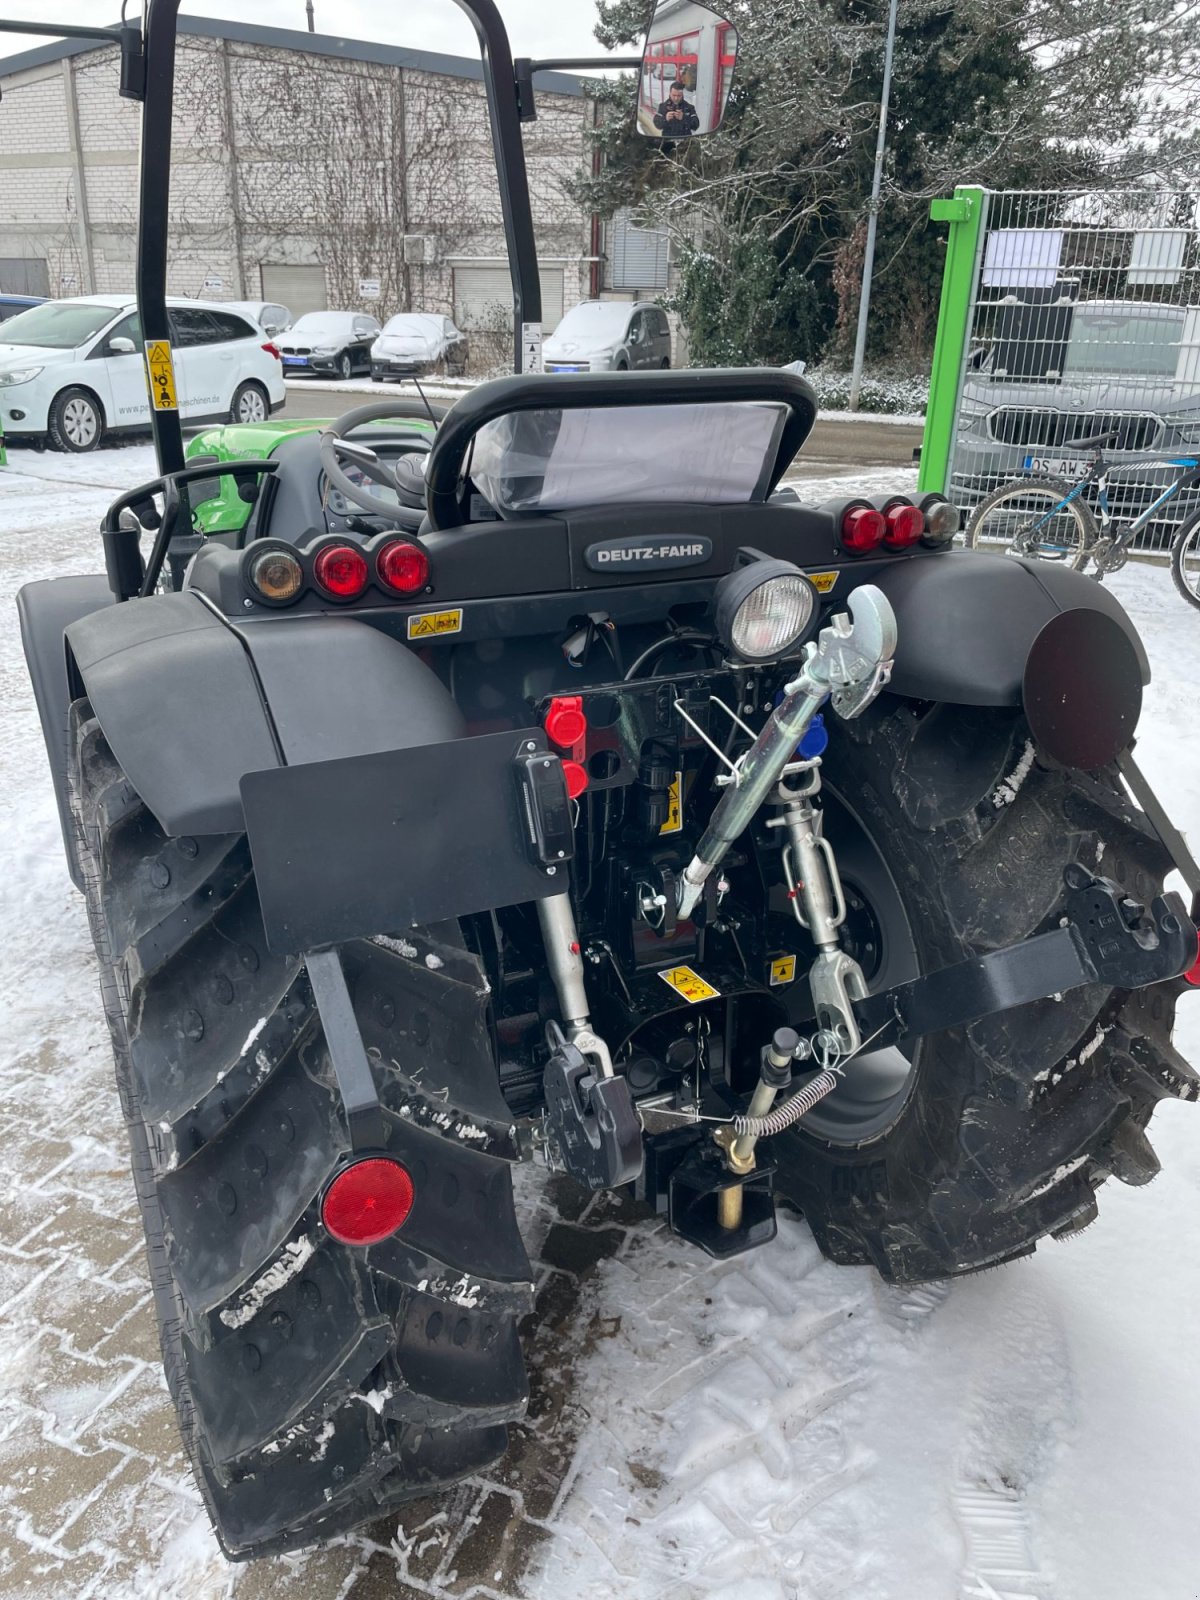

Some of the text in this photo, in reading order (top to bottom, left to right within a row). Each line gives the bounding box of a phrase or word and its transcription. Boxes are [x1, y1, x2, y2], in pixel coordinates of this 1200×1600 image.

[1032, 459, 1050, 473] OS
[1058, 460, 1077, 475] AW
[598, 544, 703, 562] DEUTZ-FAHR
[241, 1249, 303, 1307] RADIAL
